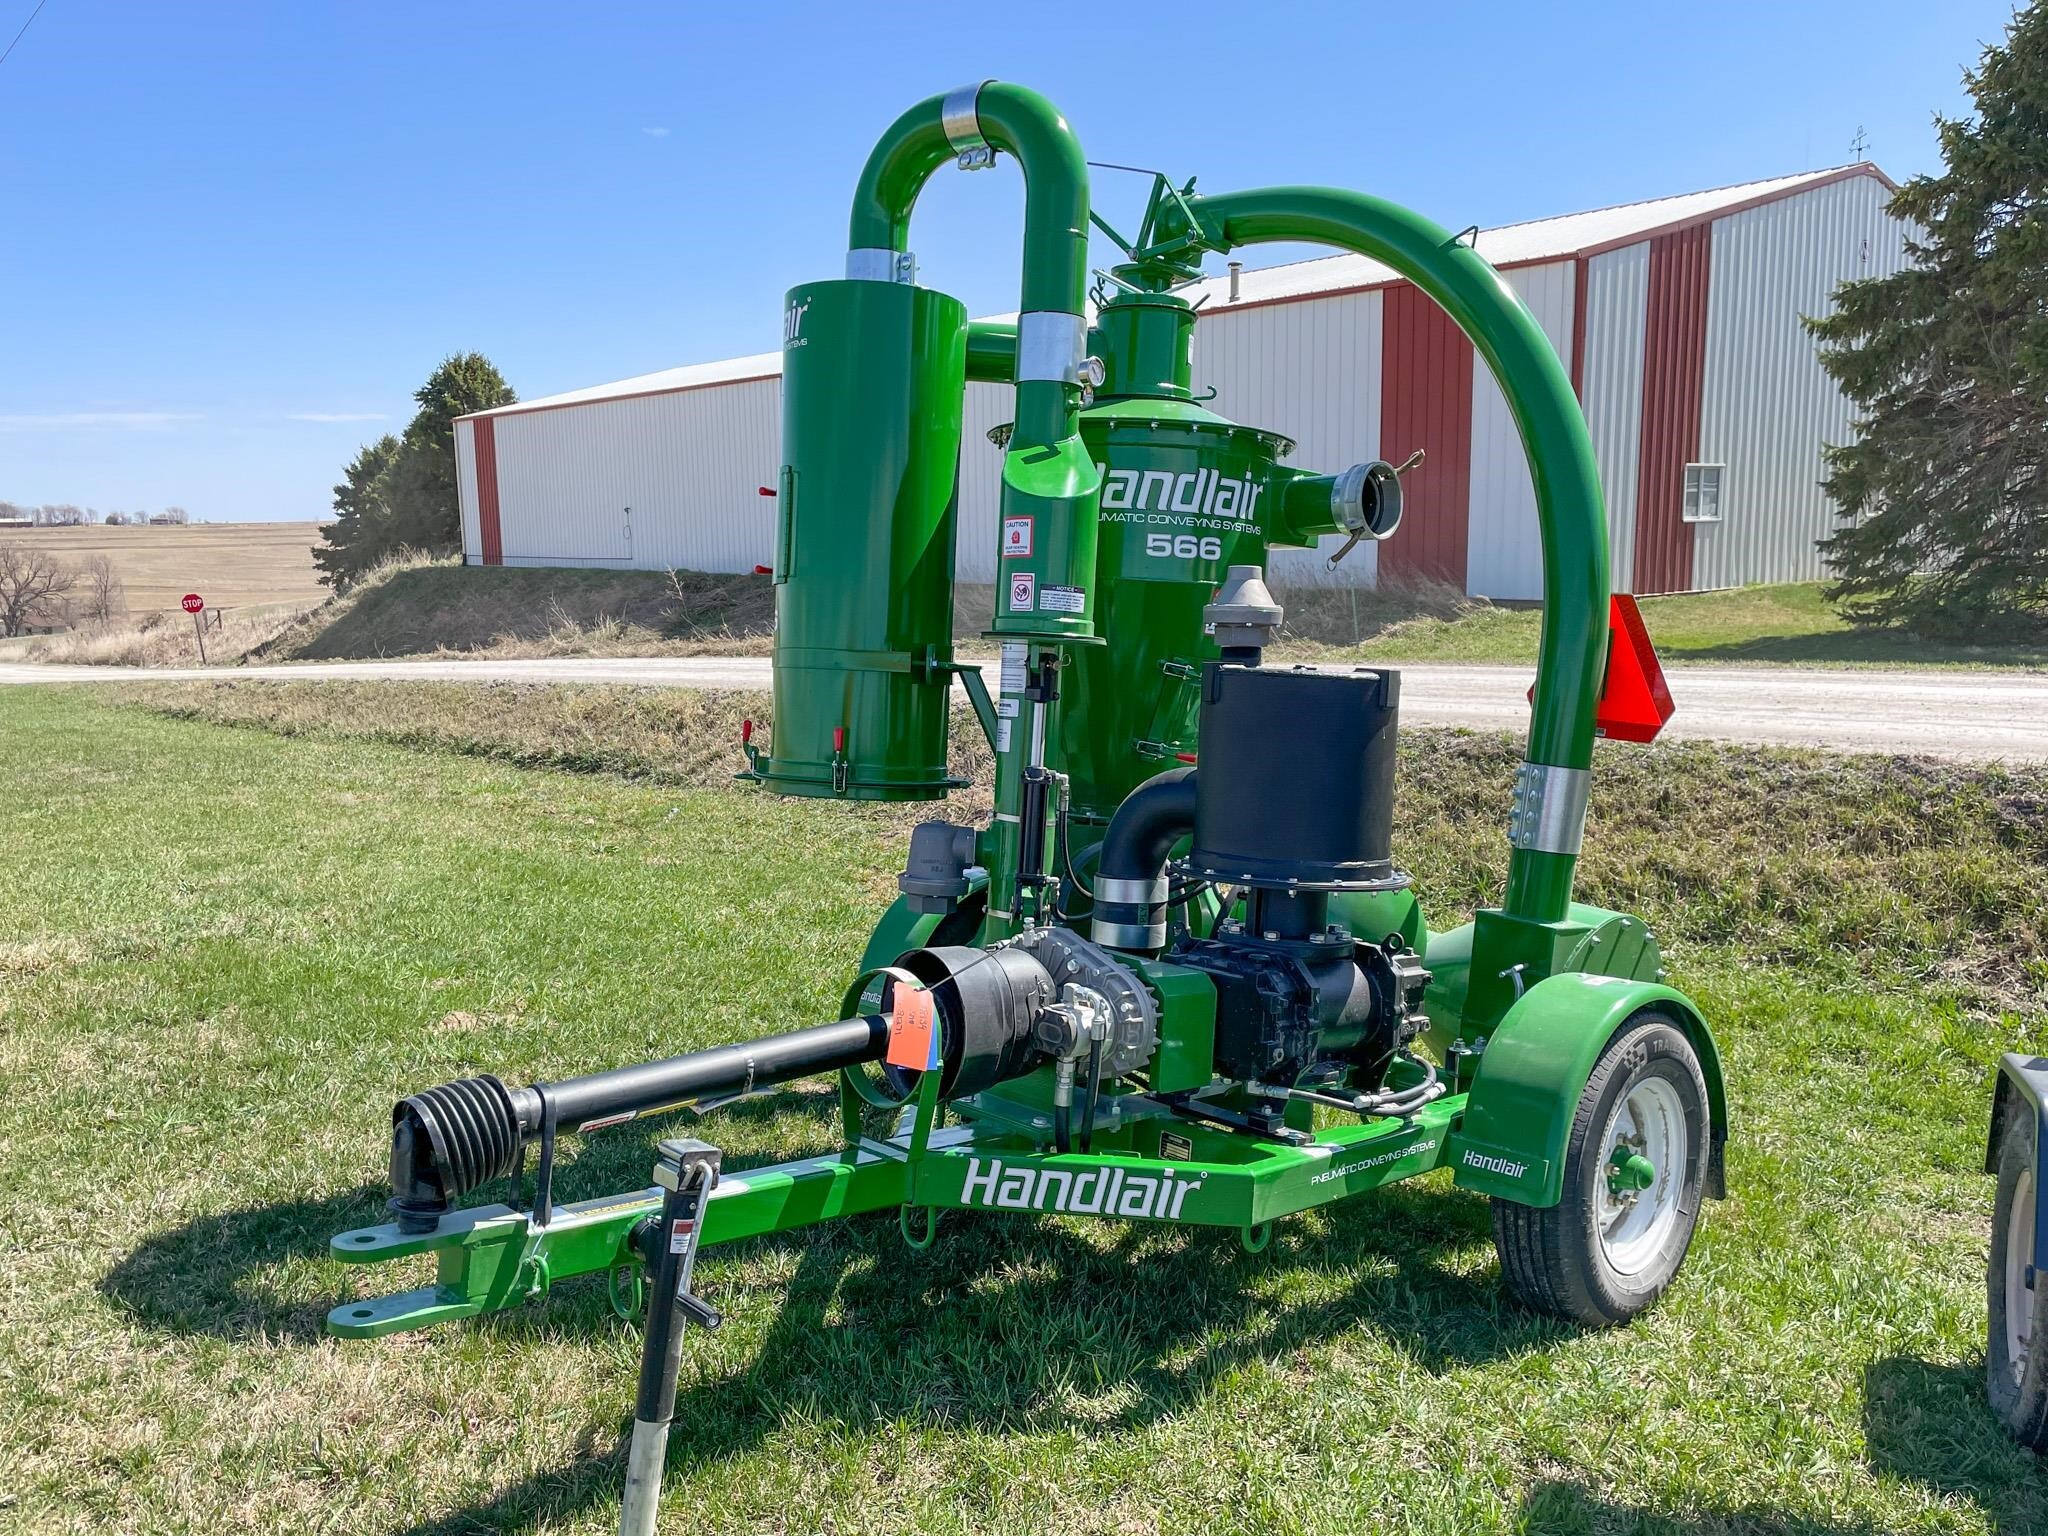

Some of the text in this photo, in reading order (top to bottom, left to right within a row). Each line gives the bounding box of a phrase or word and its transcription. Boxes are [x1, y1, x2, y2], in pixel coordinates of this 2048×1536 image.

[1097, 462, 1263, 520] andlair
[1097, 513, 1261, 536] UMATIC CONVEYING SYSTEMS
[1146, 533, 1222, 561] 566
[183, 599, 202, 609] STOP
[861, 991, 881, 1004] andla
[1311, 1139, 1436, 1185] PNEUMATIC CONVEYING SYSTEMS
[1463, 1149, 1528, 1179] Handlair
[960, 1157, 1202, 1219] Handlair
